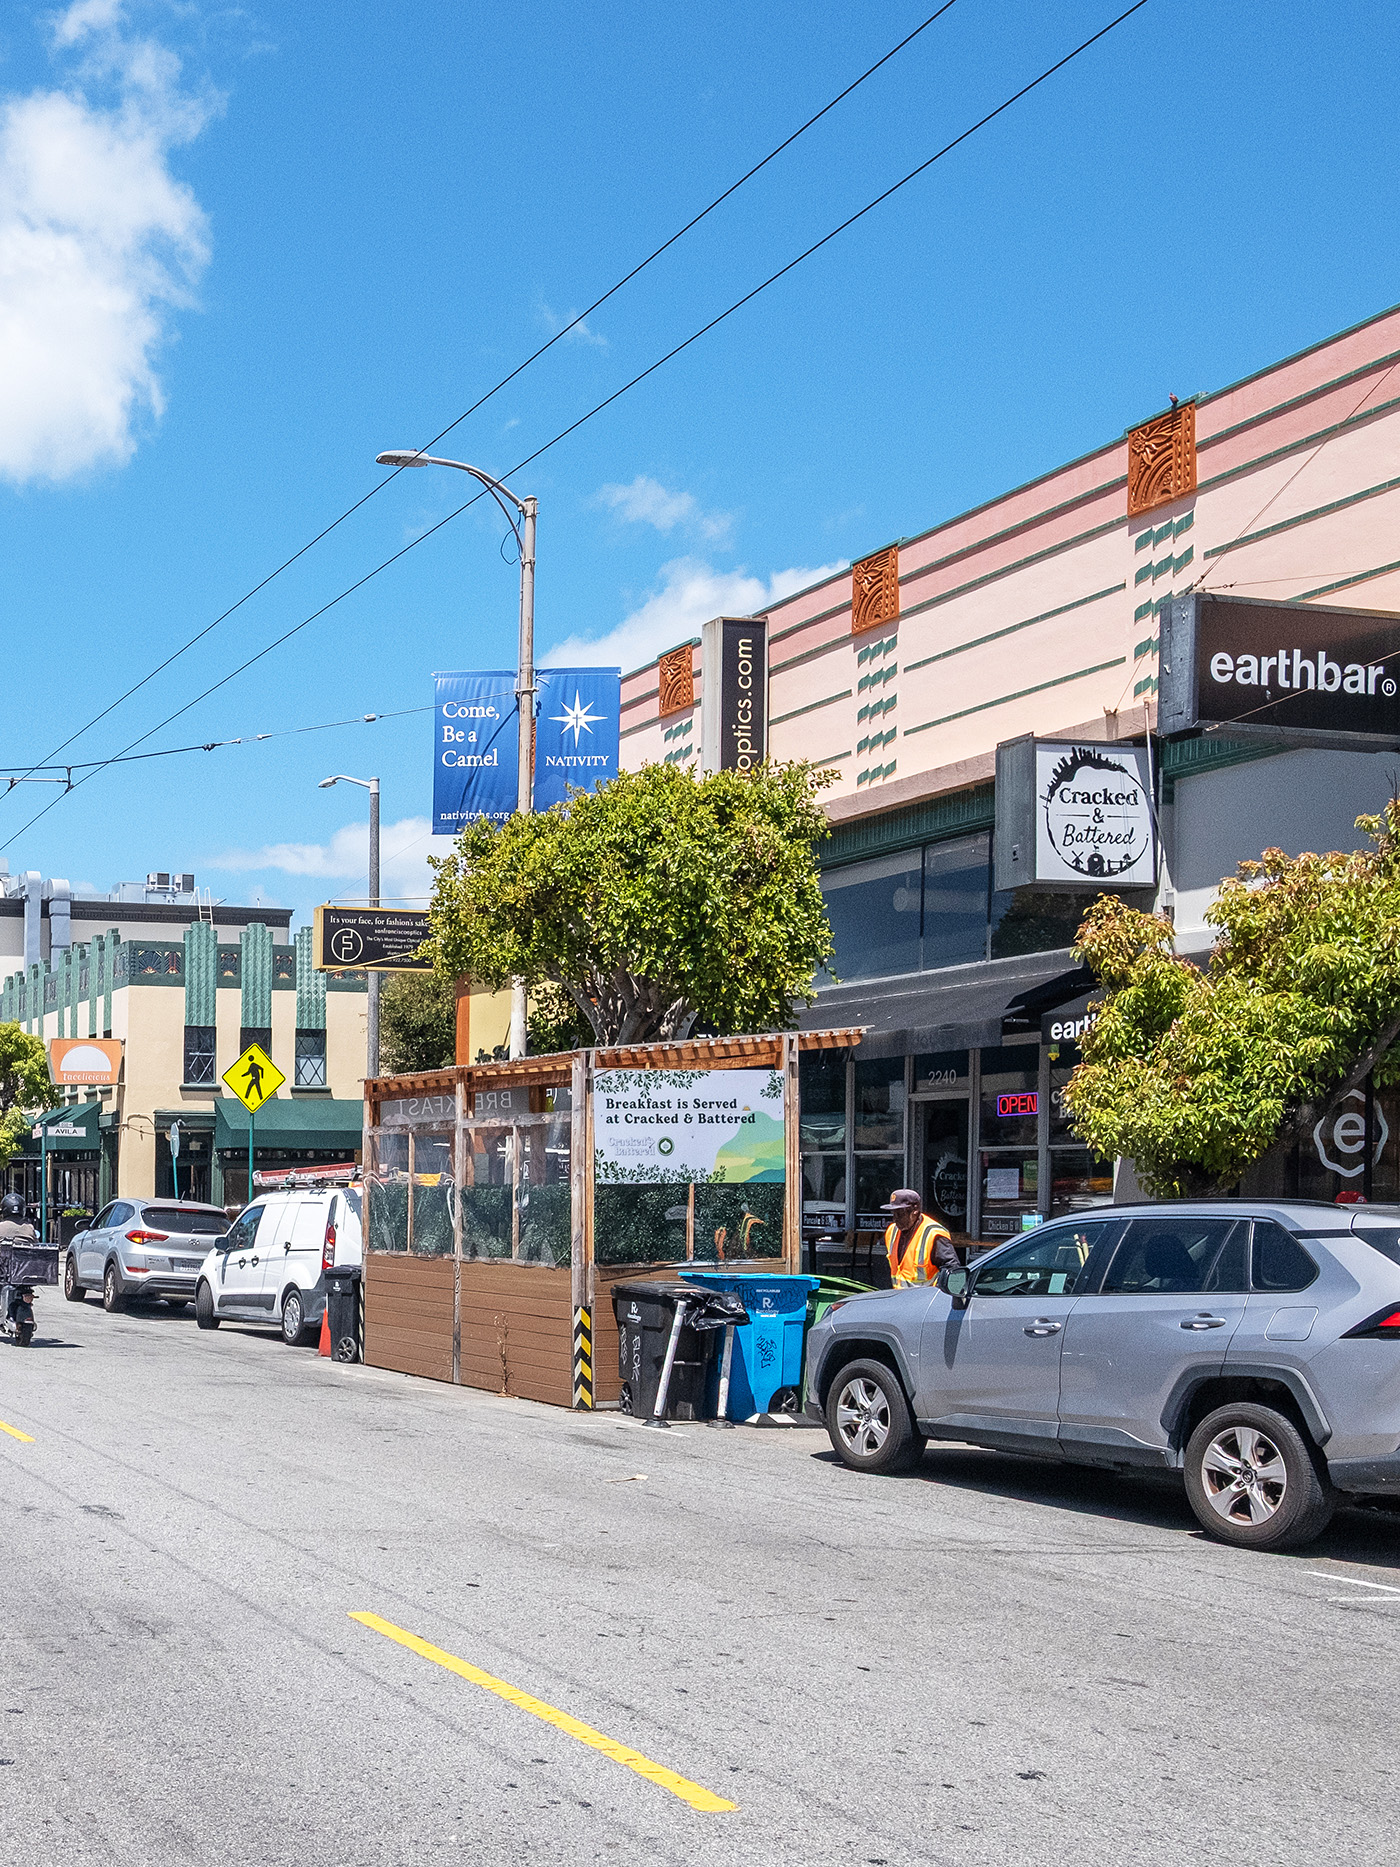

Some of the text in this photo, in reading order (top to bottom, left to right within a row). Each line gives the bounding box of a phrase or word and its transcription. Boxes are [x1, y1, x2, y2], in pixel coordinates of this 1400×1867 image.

[442, 702, 501, 721] Come,
[732, 638, 758, 771] optics.com
[442, 726, 477, 743] Be a
[441, 748, 499, 767] Camel
[545, 756, 610, 767] NATIVITY
[1059, 787, 1139, 806] Cracked
[1092, 807, 1104, 823] &
[1062, 823, 1136, 847] Battered
[341, 917, 357, 926] your
[358, 916, 374, 926] face,
[375, 917, 385, 926] for
[386, 917, 414, 927] fashion's
[63, 1073, 111, 1081] tacolicious
[928, 1069, 957, 1086] 2240
[605, 1098, 737, 1110] Breakfast is Served
[999, 1094, 1037, 1115] OPEN
[605, 1113, 756, 1124] at Cracked & Battered
[940, 1172, 967, 1181] Cracke
[940, 1189, 966, 1201] Battere
[988, 1220, 1008, 1230] Chicken
